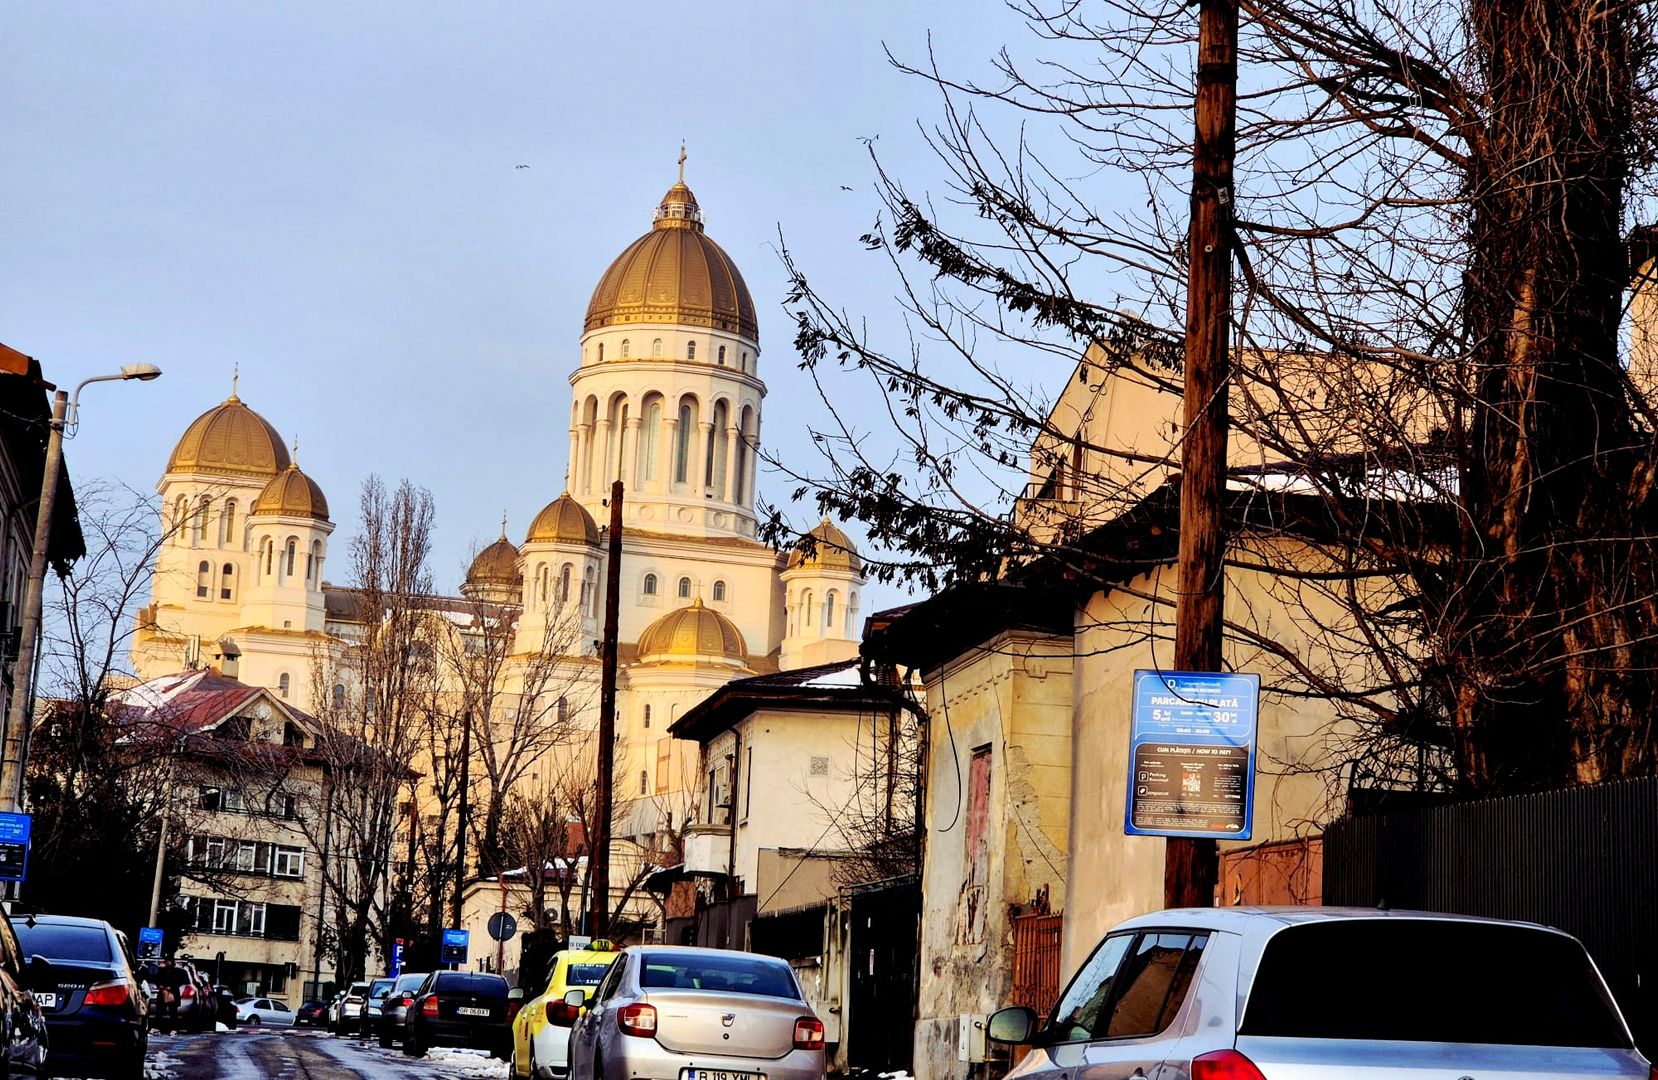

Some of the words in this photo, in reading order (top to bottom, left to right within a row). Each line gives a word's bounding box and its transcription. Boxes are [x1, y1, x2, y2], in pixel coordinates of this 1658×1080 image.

[1208, 698, 1238, 708] PLATĂ
[1153, 709, 1161, 720] 5
[1213, 711, 1229, 723] 30
[597, 940, 610, 951] TAXI
